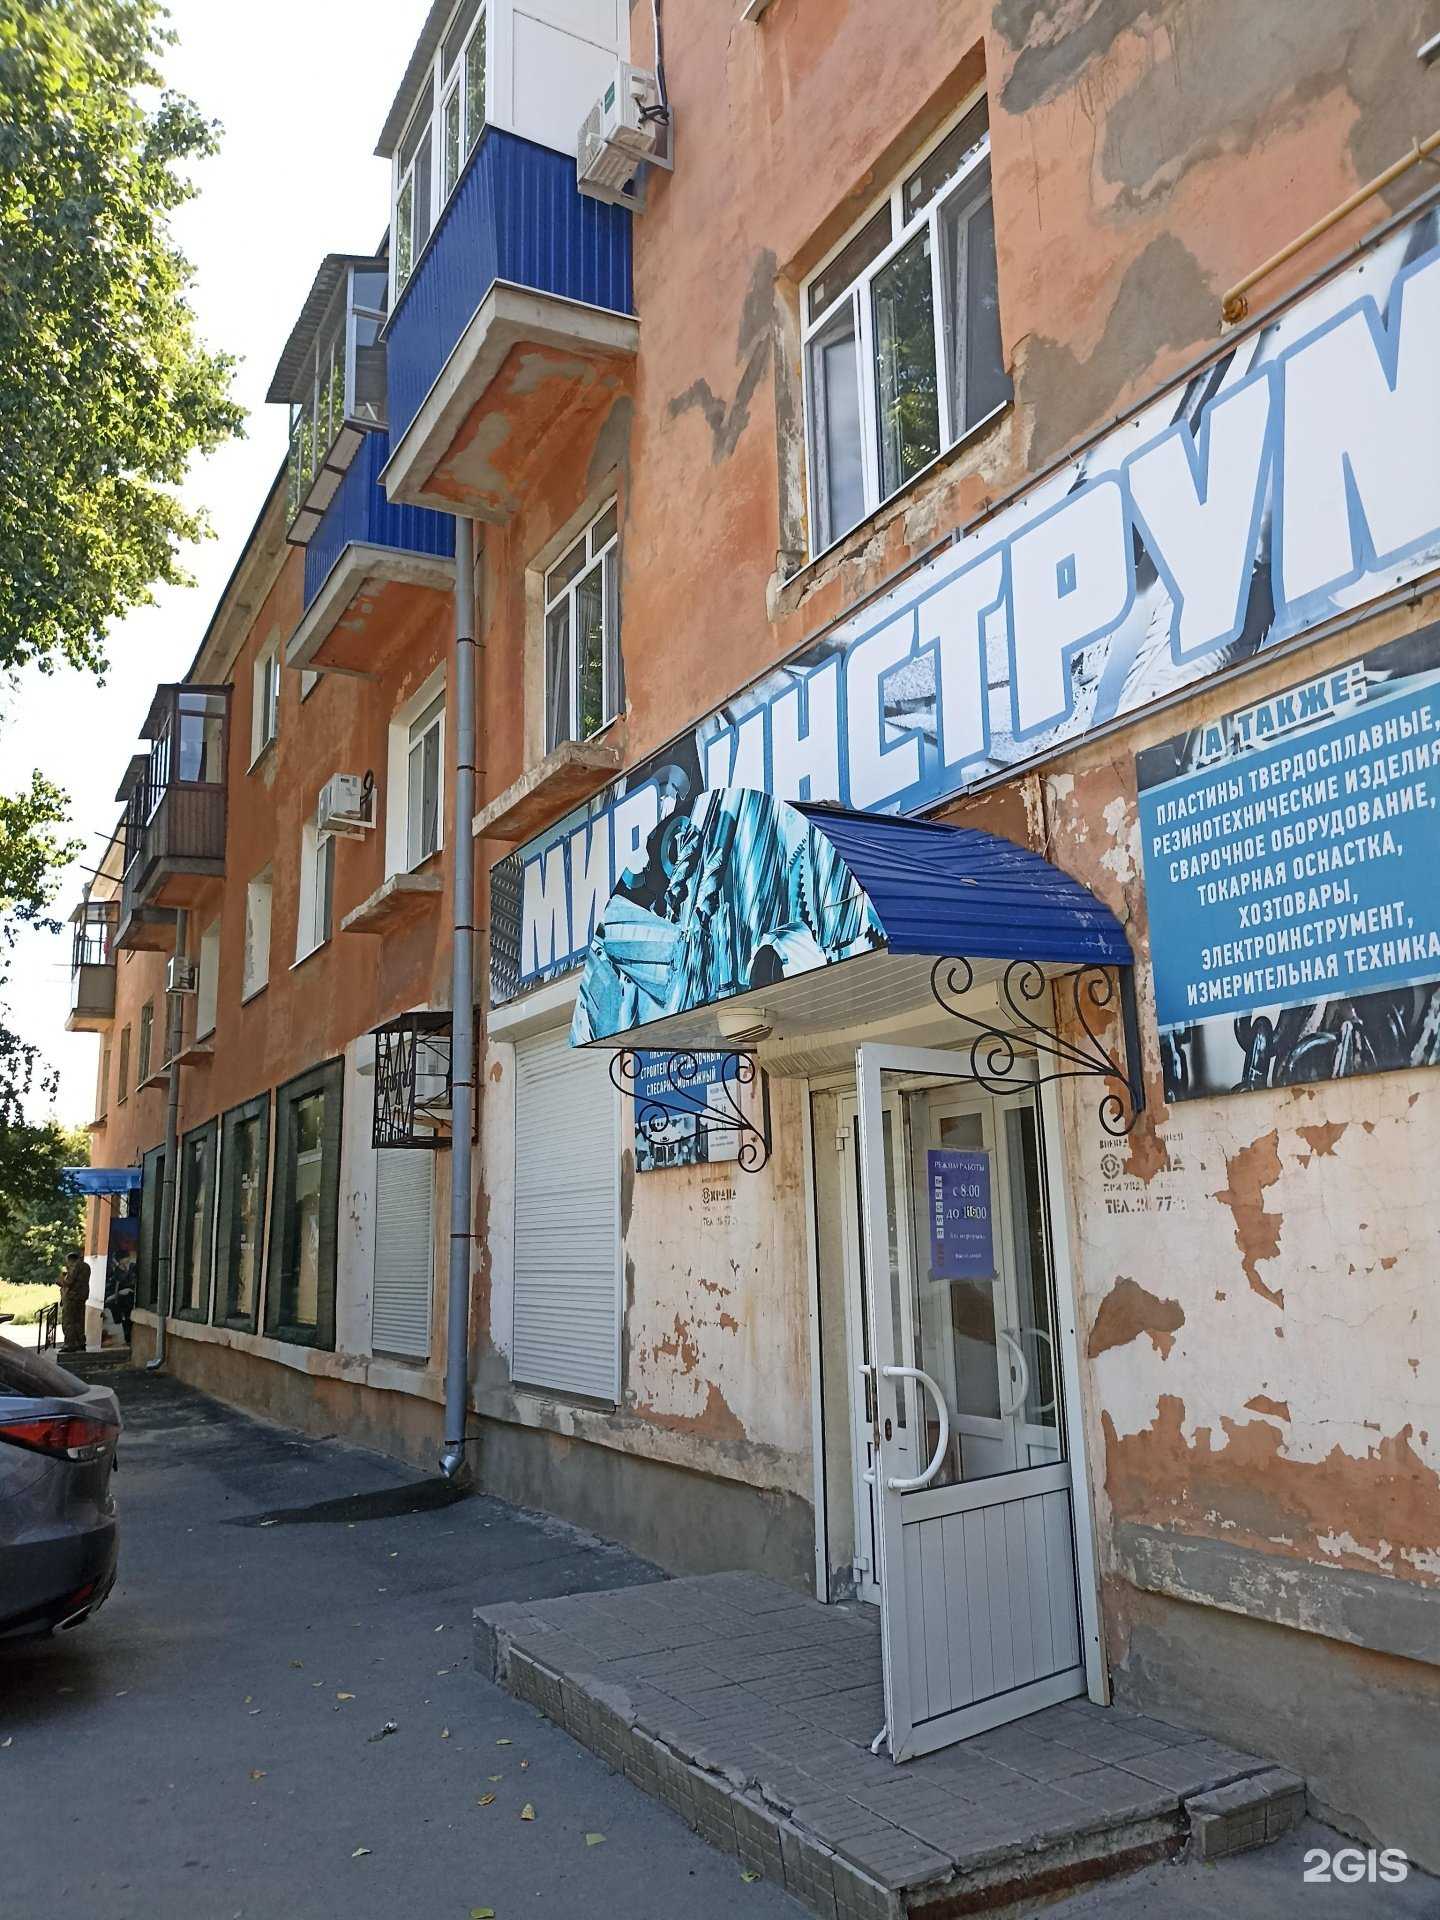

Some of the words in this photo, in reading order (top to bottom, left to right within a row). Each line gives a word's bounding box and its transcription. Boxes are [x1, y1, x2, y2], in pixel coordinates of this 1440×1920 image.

[1236, 663, 1366, 746] ТАКЖЕ:
[1153, 776, 1339, 857] РЕЗИНОТЕХНИЧЕСКИЕ
[1344, 739, 1440, 794] ИЗДЕЛИЯ
[1156, 776, 1244, 826] ПЛАСТИНЫ
[1248, 705, 1440, 793] ТВЕРДОСПЛАВНЫЕ,
[1169, 834, 1266, 882] СВАРОЧНОЕ
[1271, 782, 1437, 852] ОБОРУДОВАНИЕ,
[1198, 862, 1287, 906] ТОКАРНАЯ
[1292, 830, 1403, 880] ОСНАСТКА,
[519, 782, 662, 970] МИР
[1238, 878, 1358, 928] ХОЗТОВАРЫ,
[1187, 953, 1339, 1006] ИЗМЕРИТЕЛЬНАЯ
[1344, 931, 1440, 974] ТЕХНИКА
[1201, 901, 1414, 970] ЭЛЕКТРОИНСТРУМЕНТ,
